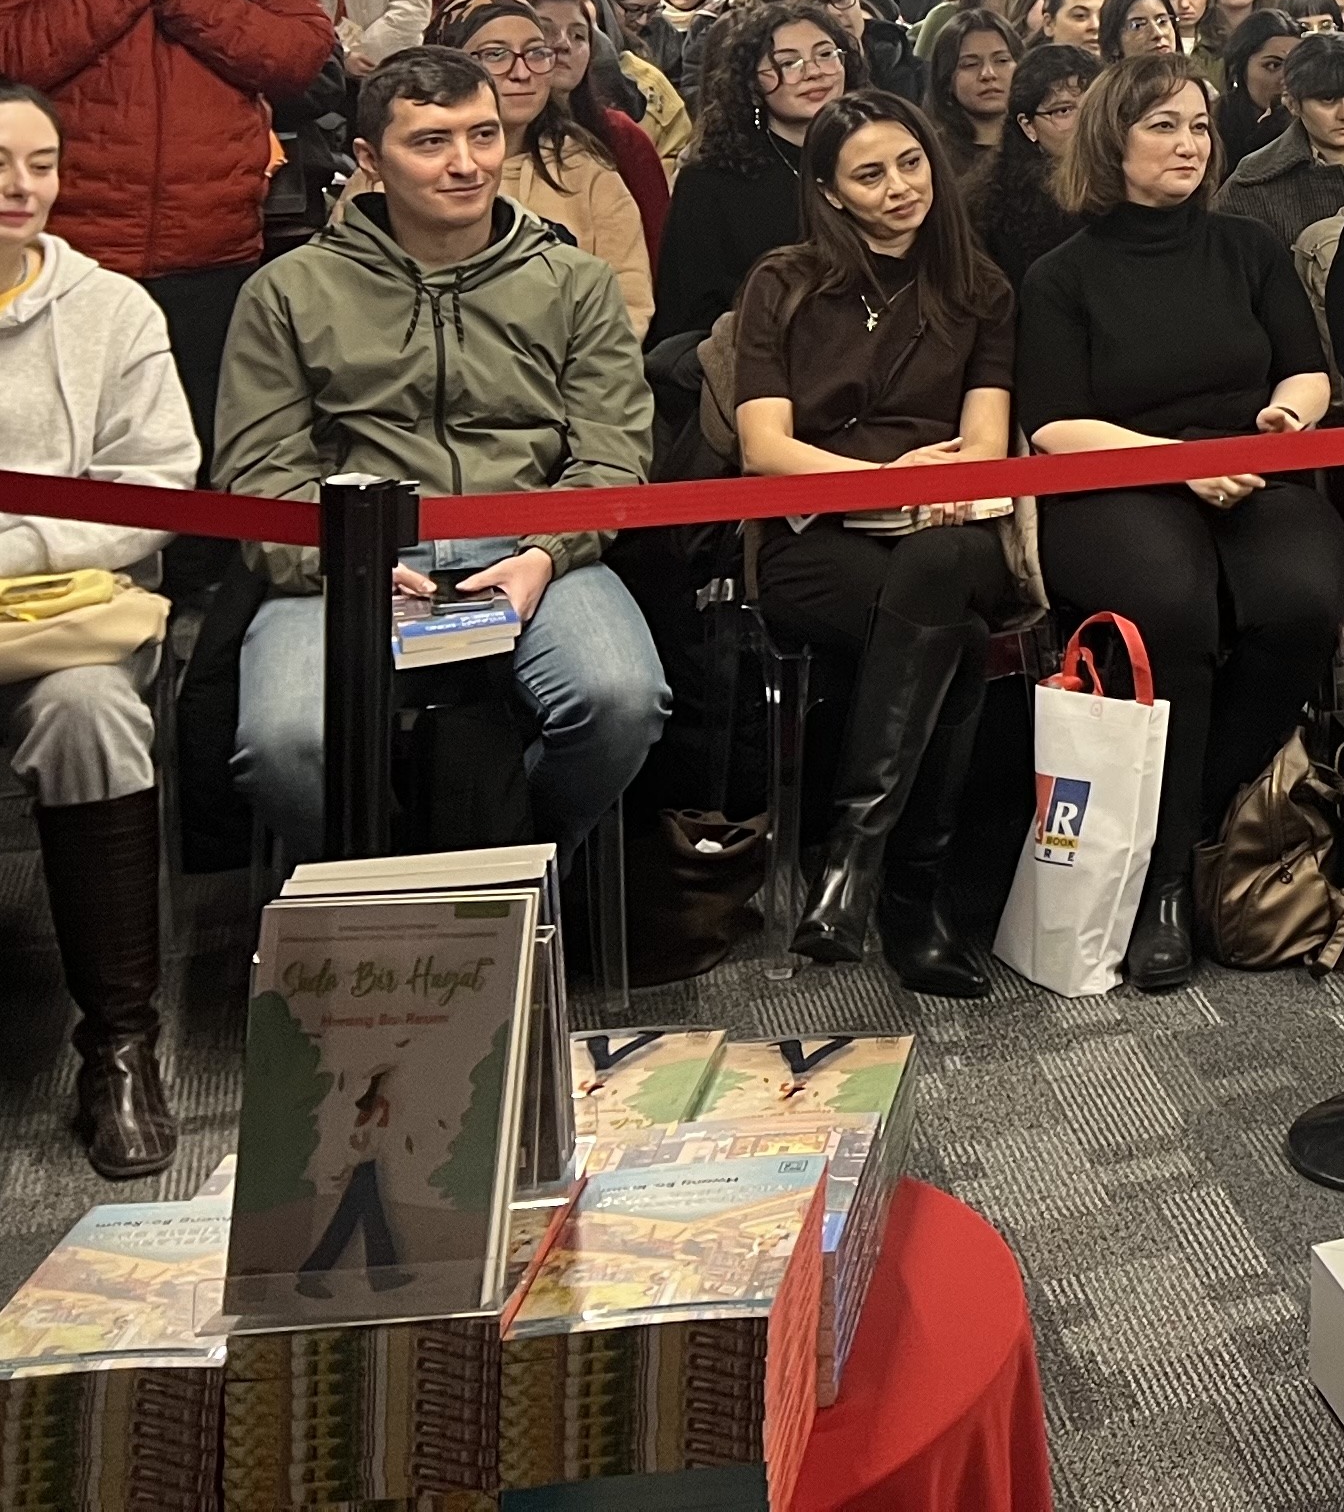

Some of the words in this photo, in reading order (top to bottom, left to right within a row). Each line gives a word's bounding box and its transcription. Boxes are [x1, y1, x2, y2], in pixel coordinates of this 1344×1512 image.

[1045, 837, 1075, 847] BOOK
[350, 960, 398, 998] Bir
[405, 955, 496, 1007] Hayat
